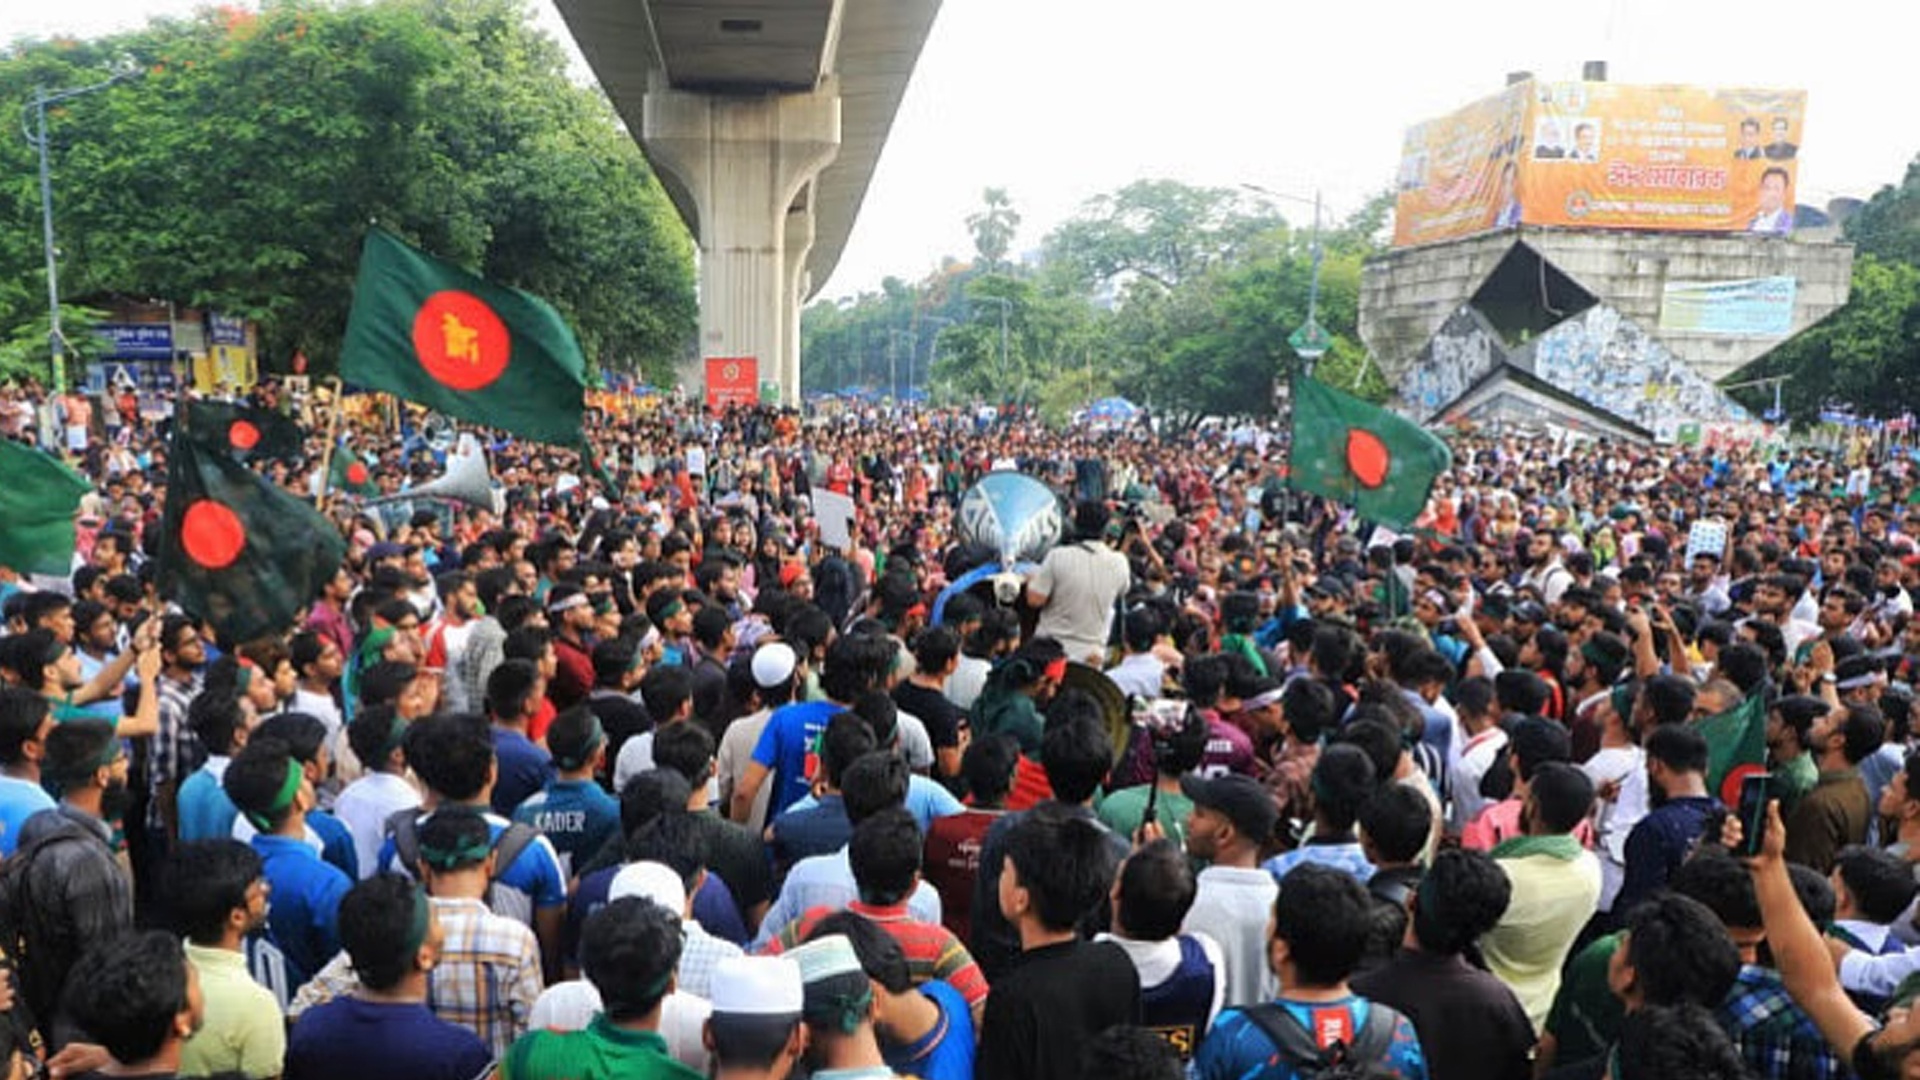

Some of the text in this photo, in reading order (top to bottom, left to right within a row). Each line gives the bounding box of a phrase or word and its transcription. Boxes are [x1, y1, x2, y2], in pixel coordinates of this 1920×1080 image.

[1608, 159, 1727, 190] ঈদ মোবারক
[533, 811, 586, 832] KADER
